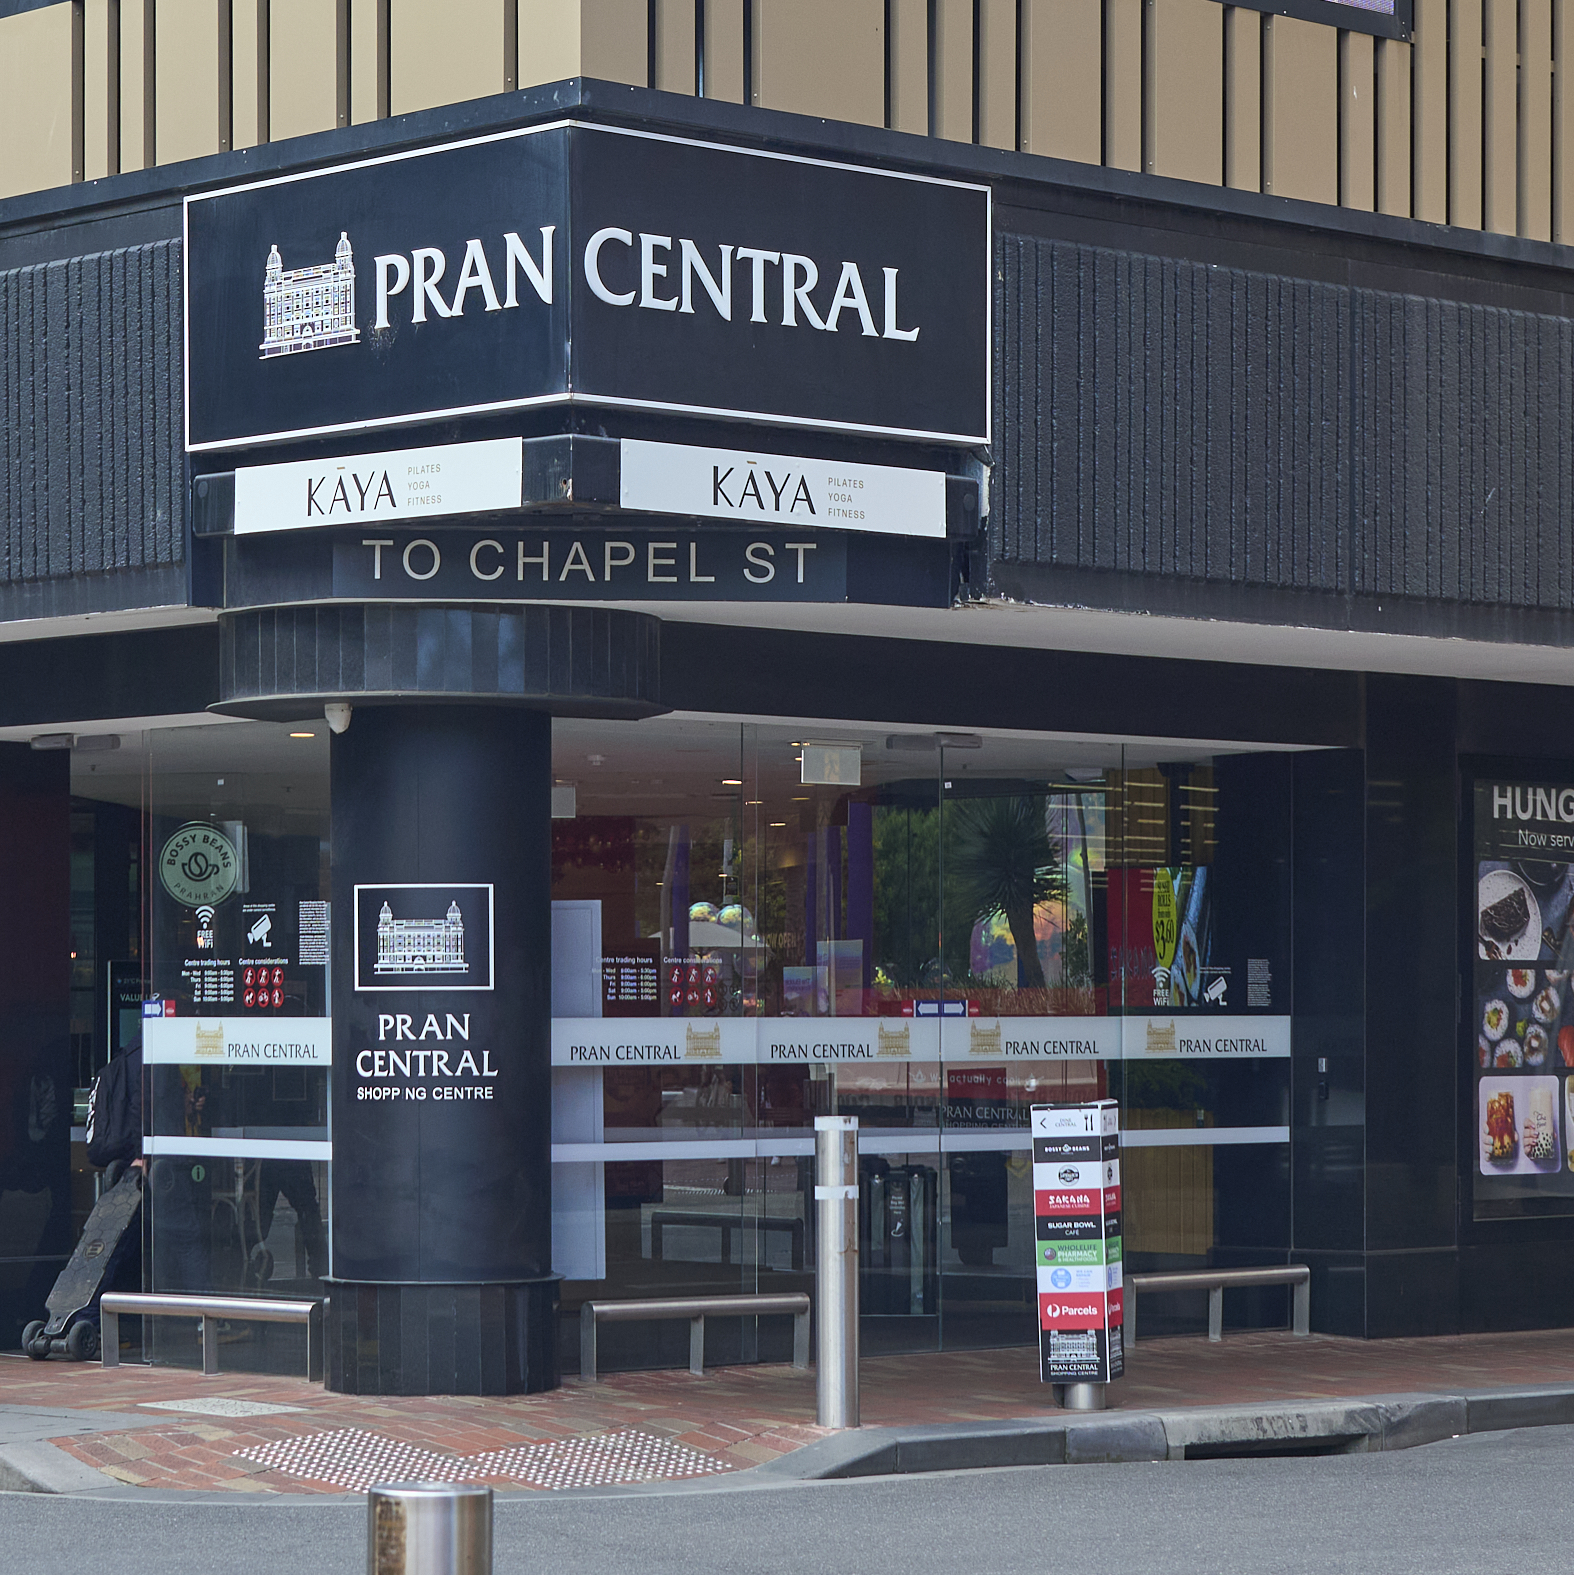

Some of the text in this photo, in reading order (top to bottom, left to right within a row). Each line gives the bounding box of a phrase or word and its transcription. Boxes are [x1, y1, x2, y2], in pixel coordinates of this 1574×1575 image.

[374, 224, 920, 343] PRAN CENTRAL
[407, 464, 441, 475] PILATES
[408, 480, 431, 491] YOGA
[828, 477, 864, 489] PILATES
[407, 495, 442, 506] FITNESS
[828, 492, 853, 503] YOGA
[828, 508, 866, 519] FITNESS
[362, 538, 818, 584] TO CHAPEL ST
[1518, 829, 1547, 846] Now
[167, 833, 232, 869] BOSSY BEANS
[174, 881, 225, 901] PRAHRAN
[197, 930, 213, 939] FREE
[184, 959, 200, 967] Centre
[201, 959, 216, 967] trading
[255, 958, 289, 966] considerations
[595, 956, 653, 965] Centre trading hours
[663, 956, 682, 964] Centre
[1153, 989, 1169, 997] FREE
[1153, 997, 1170, 1006] WiFi
[378, 1013, 470, 1040] PRAN
[228, 1043, 318, 1059] PRAN CENTRAL
[770, 1043, 874, 1059] PRAN CENTRAL
[1005, 1040, 1100, 1056] PRAN CENTRAL
[1179, 1038, 1267, 1053] PRAN CENTRAL
[570, 1044, 681, 1061] PRAN CENTRAL
[356, 1050, 498, 1078] CENTRAL
[950, 1074, 992, 1085] actually
[356, 1086, 494, 1100] SHOPPNG CENTRE
[943, 1106, 1029, 1121] PRAN CENTRAL
[1048, 1195, 1090, 1205] SAKANA
[1048, 1221, 1073, 1229] SUGAR
[1061, 1305, 1098, 1316] Parcels
[1069, 1363, 1098, 1371] CENTRAL
